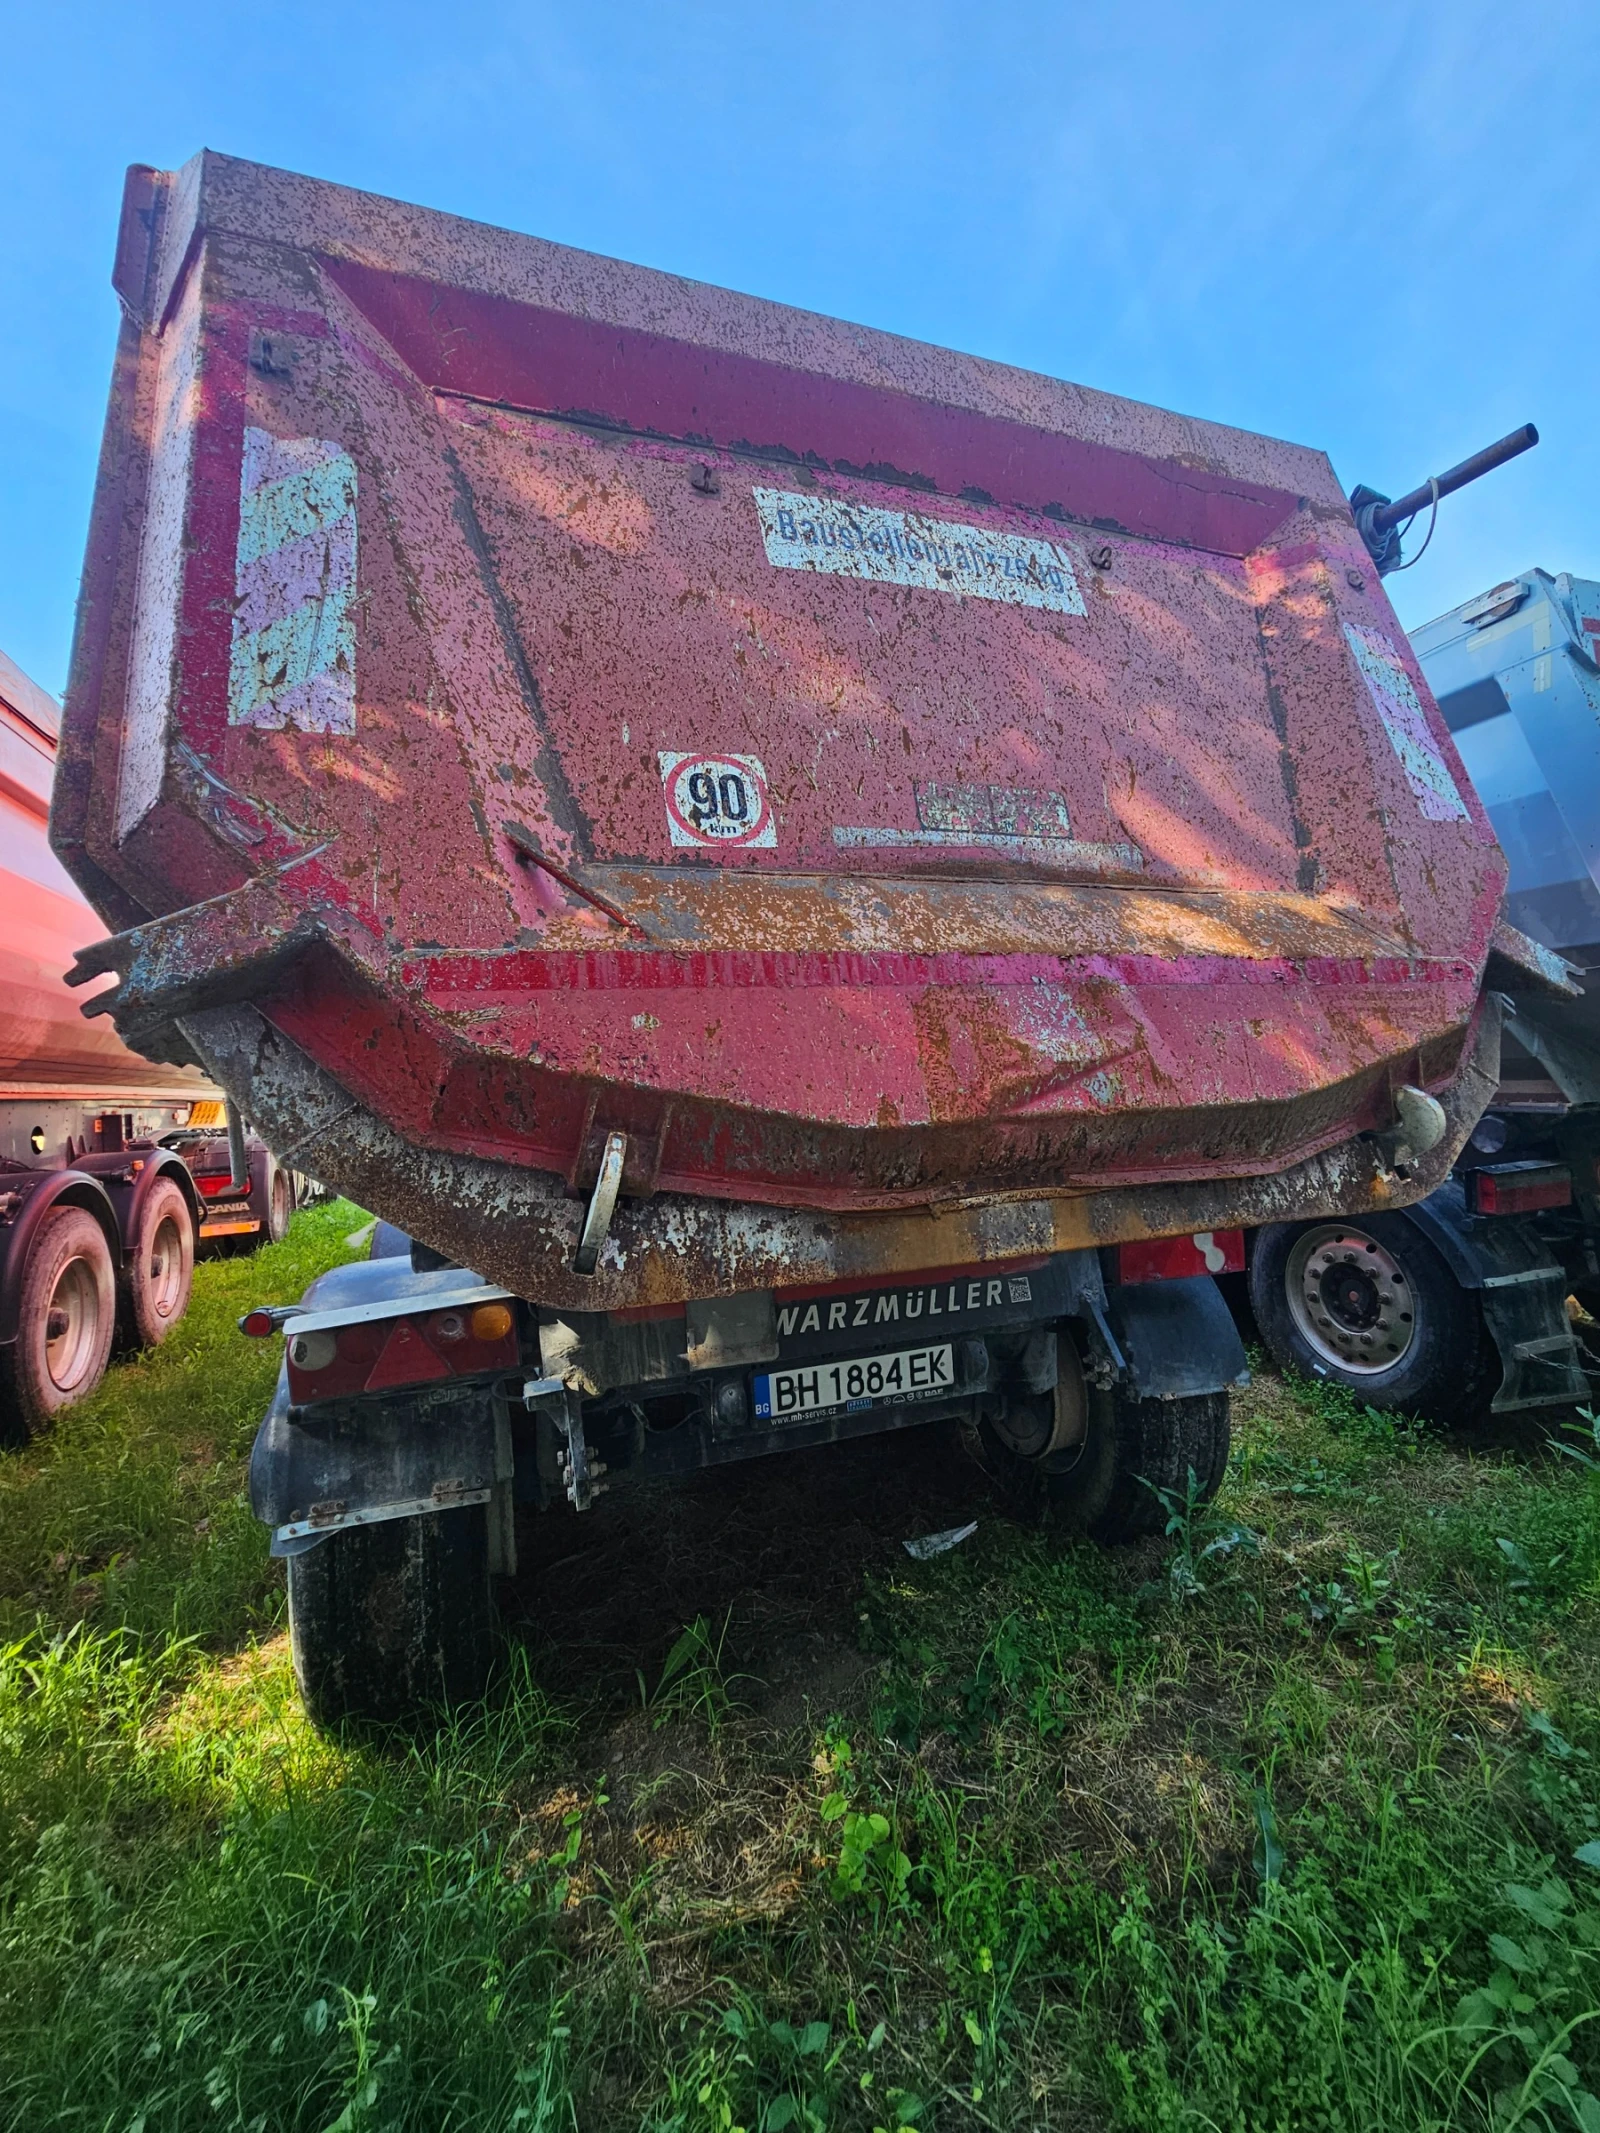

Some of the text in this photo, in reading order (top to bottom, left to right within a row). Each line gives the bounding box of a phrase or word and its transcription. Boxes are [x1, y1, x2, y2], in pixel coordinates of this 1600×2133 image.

[689, 773, 748, 821] 90
[709, 823, 737, 834] km
[776, 1349, 948, 1412] BH 1884 EK
[755, 1402, 770, 1415] BG
